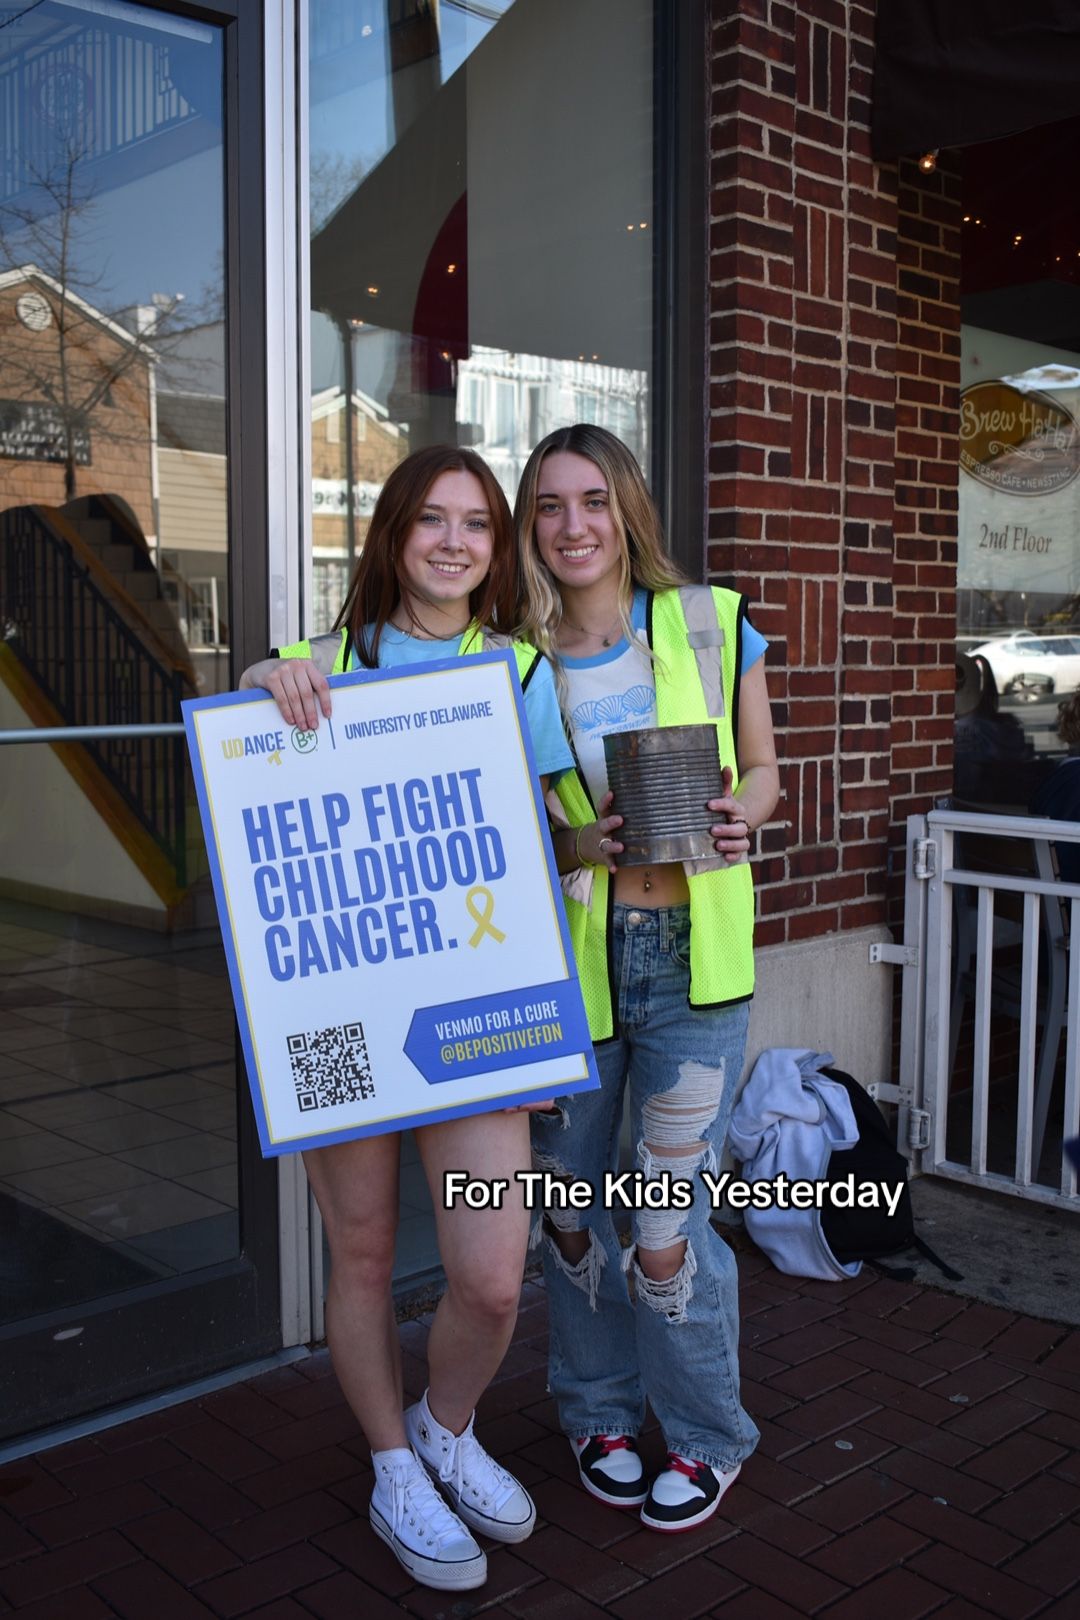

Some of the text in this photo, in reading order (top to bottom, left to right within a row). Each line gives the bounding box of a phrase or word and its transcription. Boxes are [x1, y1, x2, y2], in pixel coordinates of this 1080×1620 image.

[960, 400, 1016, 440] Brew
[960, 449, 1001, 483] ESPRESSO
[979, 523, 1053, 554] 2nd Floor
[345, 701, 493, 740] UNIVERSITY OF DELAWARE
[221, 731, 286, 760] UDANCE
[242, 768, 485, 864] HELP FIGHT
[253, 825, 507, 922] CHILDHOOD
[264, 897, 458, 982] CANCER.
[434, 1000, 560, 1041] VENMO FOR A CURE
[440, 1022, 563, 1064] @BEPOSITIVEFDN
